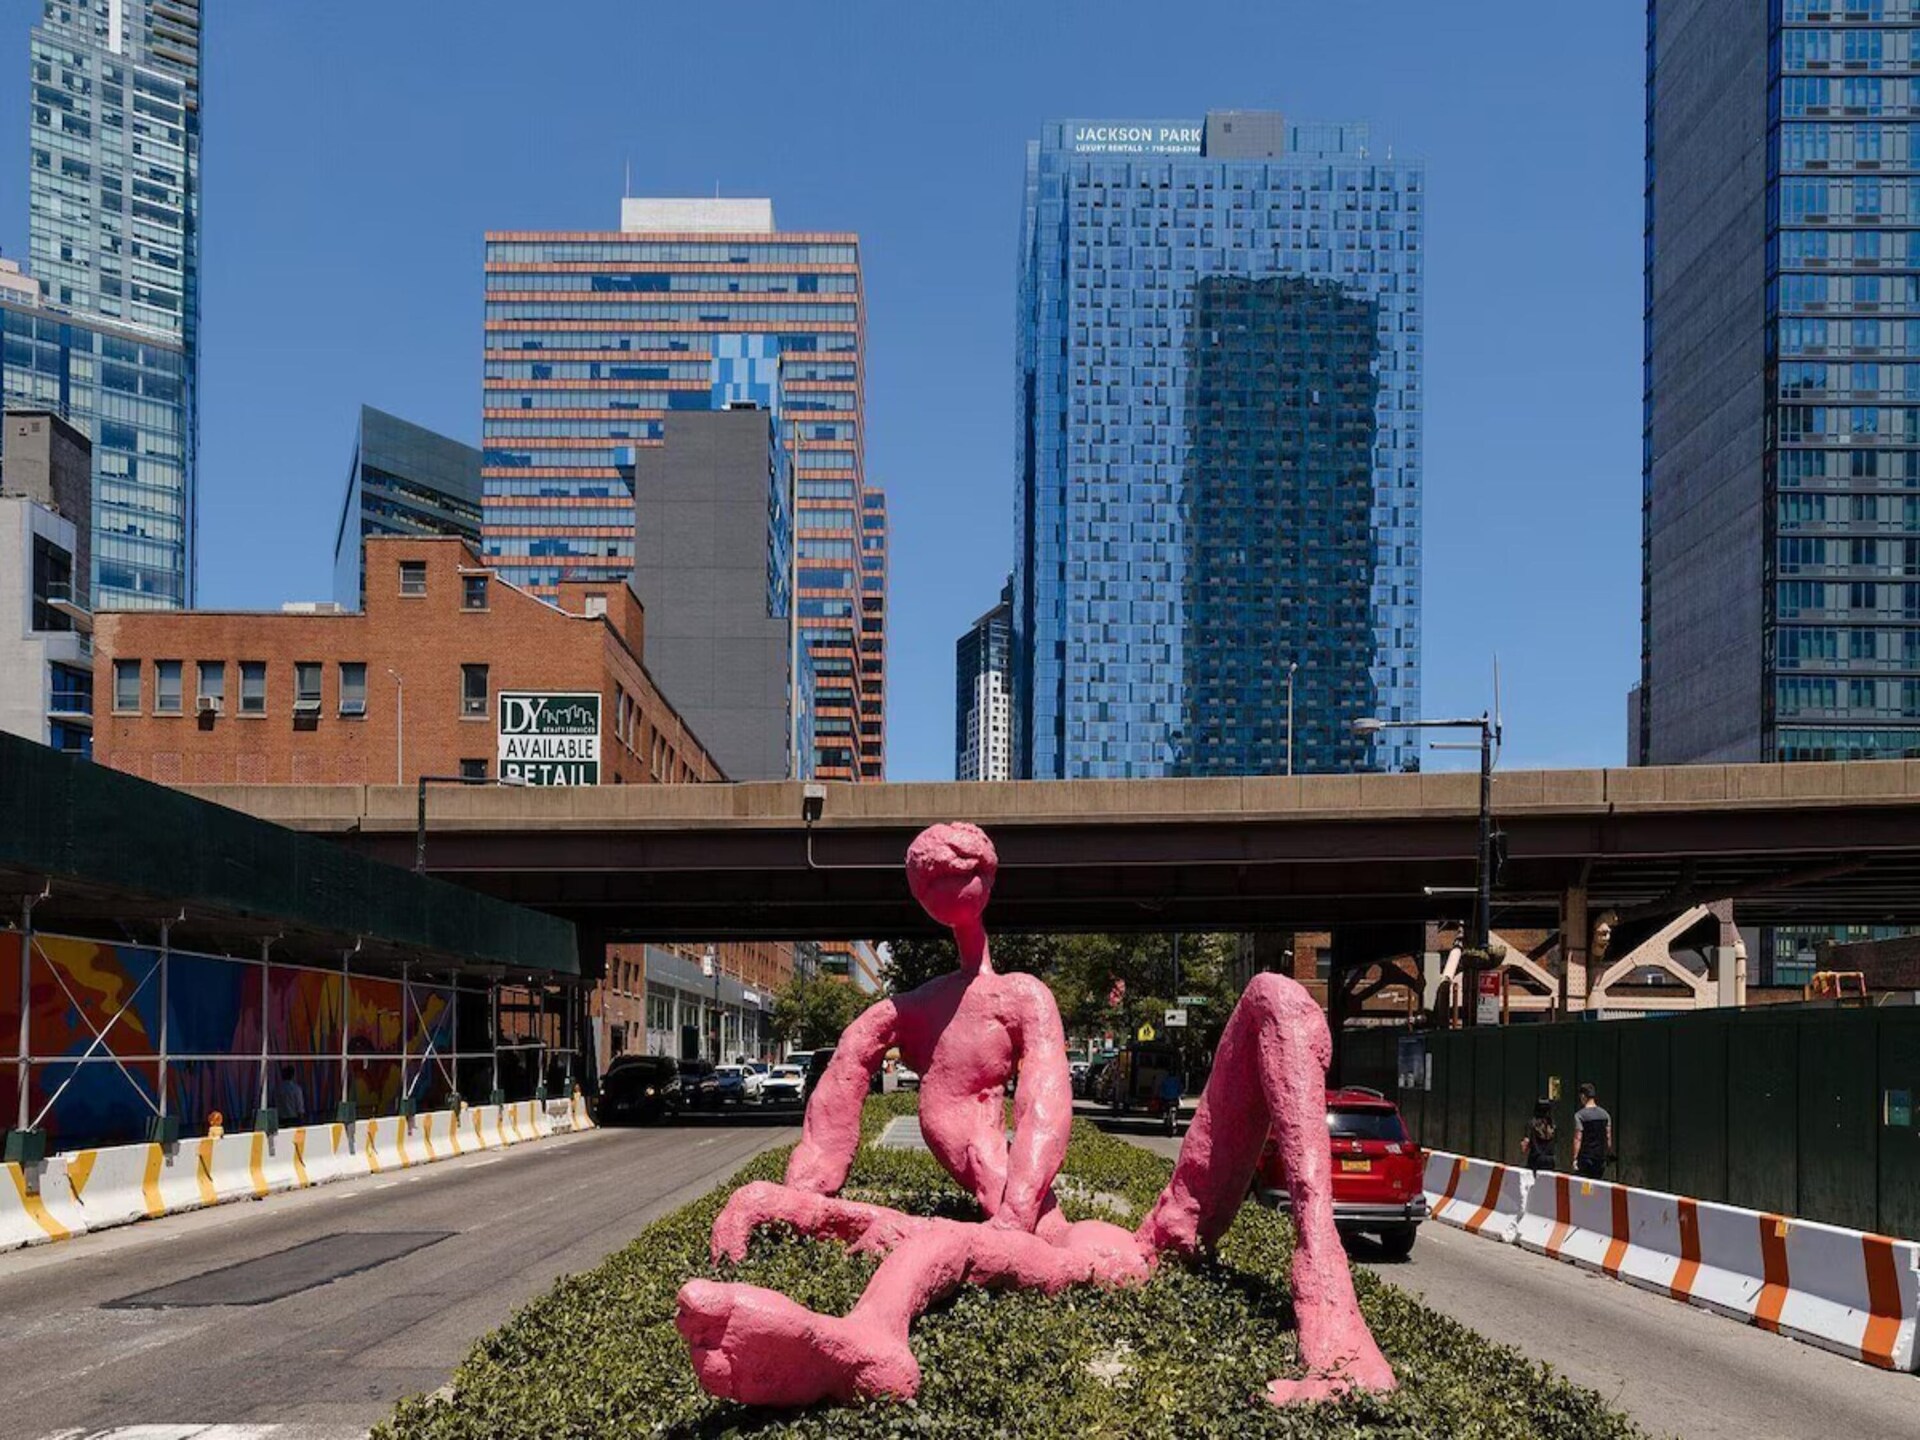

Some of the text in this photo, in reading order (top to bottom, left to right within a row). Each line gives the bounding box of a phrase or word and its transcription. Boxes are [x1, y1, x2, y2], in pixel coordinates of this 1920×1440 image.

[1076, 127, 1201, 142] JACKSON PARK
[1075, 144, 1106, 153] LUXURY
[1108, 144, 1142, 153] RENTALS
[502, 698, 548, 733] DY
[506, 738, 593, 759] AVAILABLE
